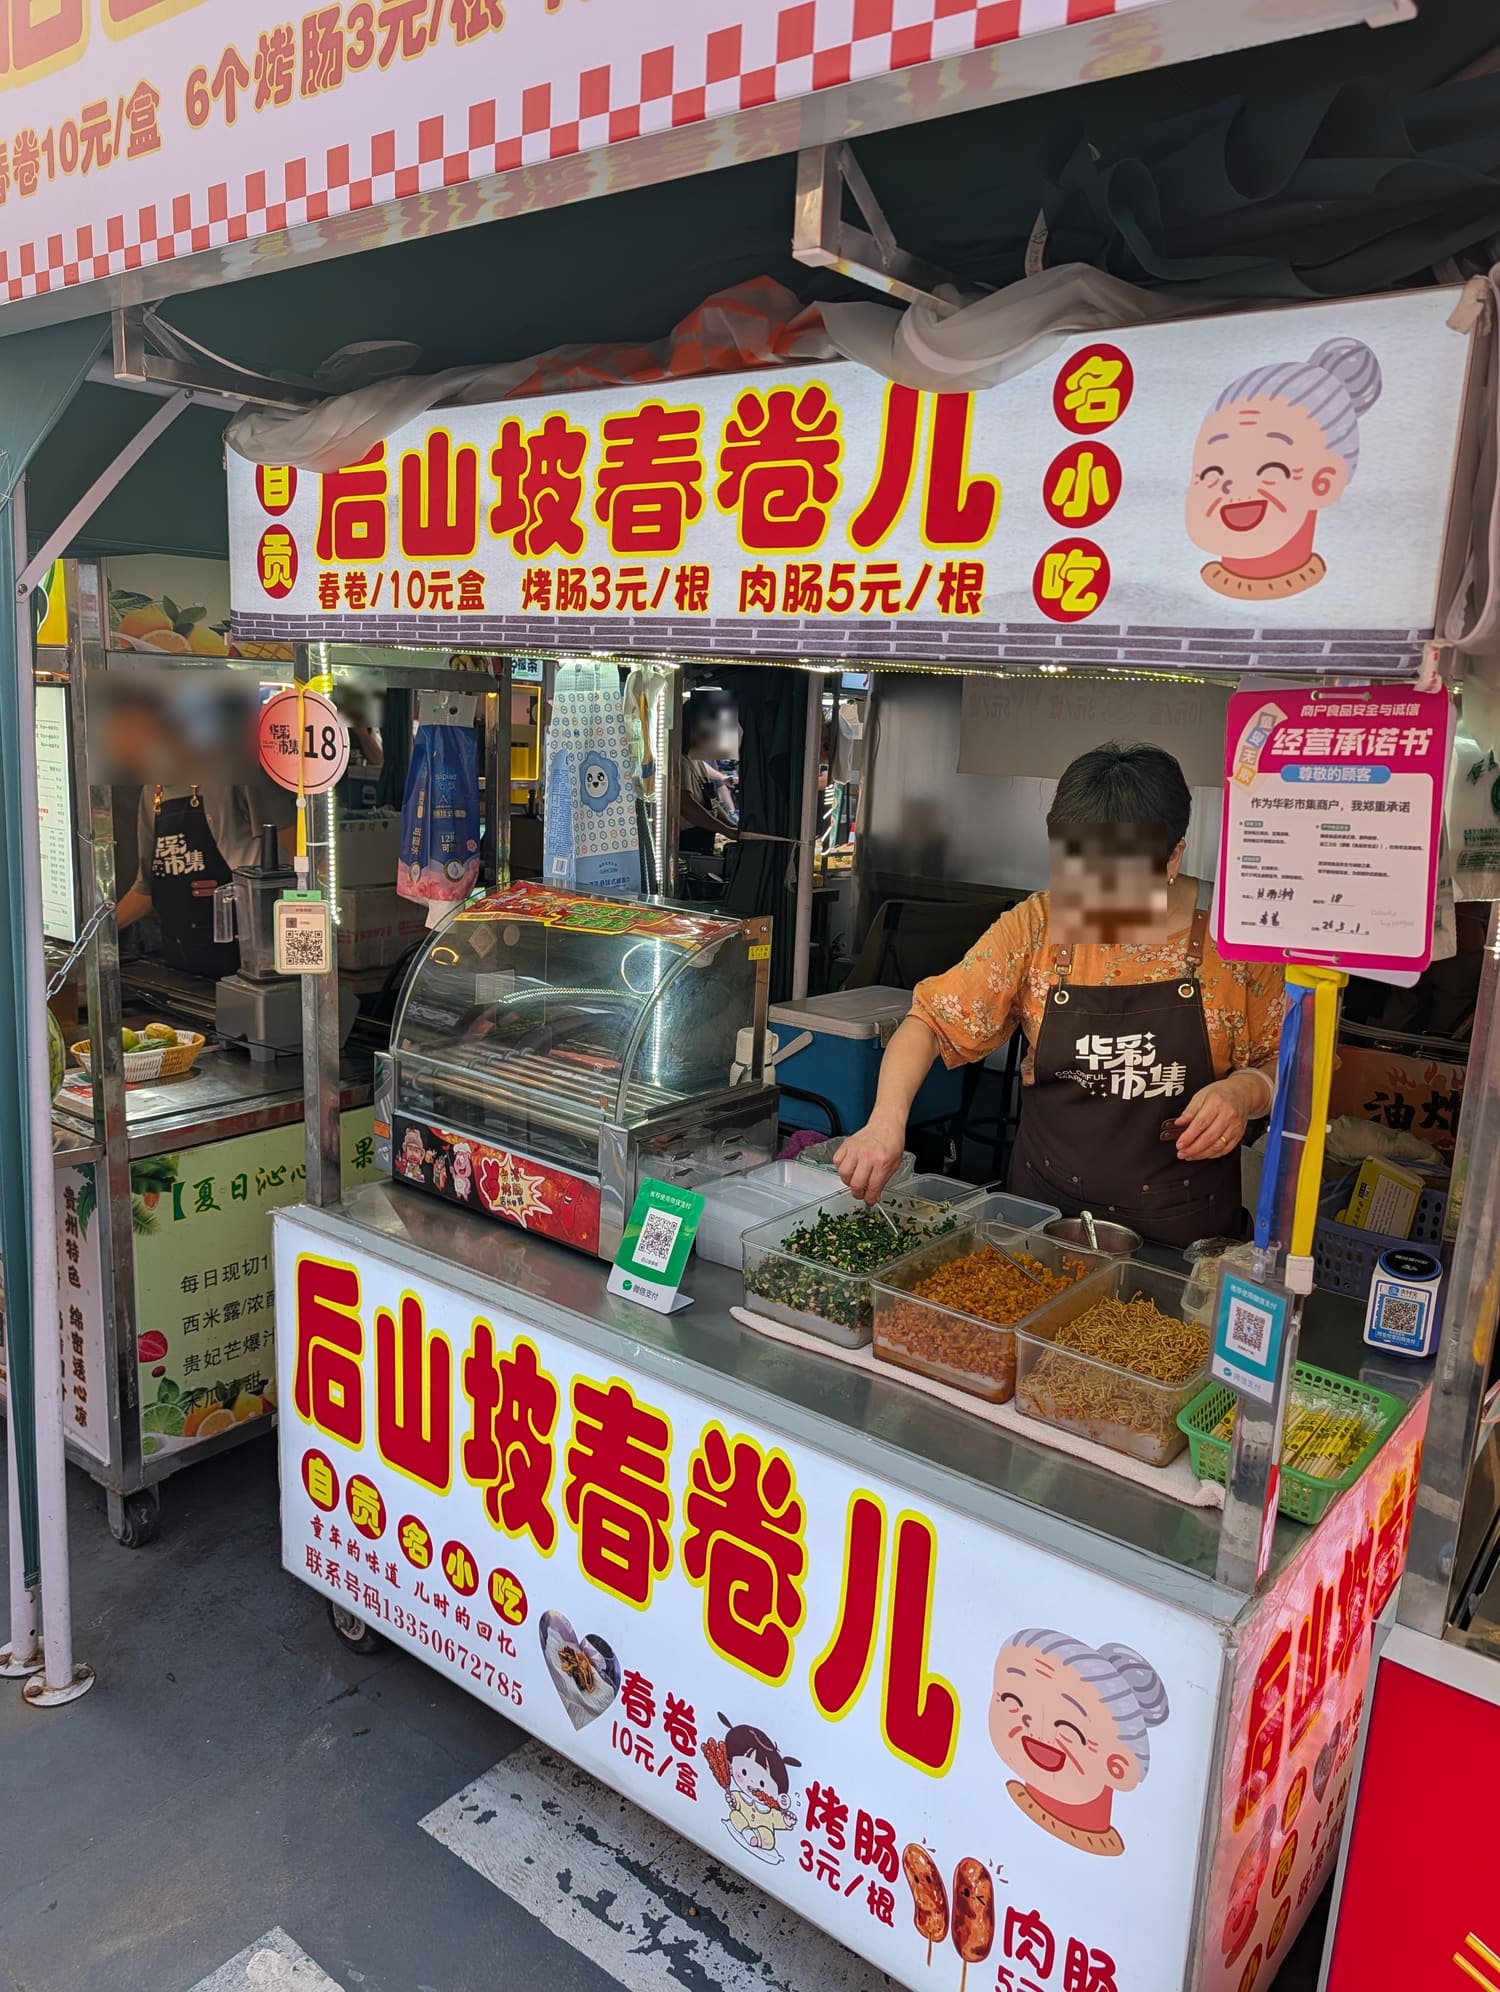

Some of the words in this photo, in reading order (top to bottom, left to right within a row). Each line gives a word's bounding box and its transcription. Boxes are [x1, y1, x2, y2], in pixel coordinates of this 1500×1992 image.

[313, 378, 1000, 565] 后山坡春卷儿
[1038, 353, 1126, 614] 名小吃
[259, 464, 295, 591] 自贡
[317, 568, 487, 611] 春卷/10元盒
[520, 564, 711, 613] 烤肠3元/根
[738, 560, 985, 616] 肉肠5元/根
[303, 725, 337, 761] 18
[1270, 726, 1434, 758] 经营承诺书
[1300, 703, 1421, 719] 商户食品安全与诚信
[1298, 765, 1372, 783] 尊敬的顾客
[1075, 1031, 1157, 1071] 华彩
[1110, 1061, 1188, 1100] 市集
[351, 1136, 374, 1169] 果
[63, 1185, 81, 1289] 贵州特色
[180, 1254, 268, 1294] 每日现切1
[632, 1284, 659, 1302] 微信支付
[292, 1250, 962, 1779] 后山坡春卷儿
[310, 1514, 401, 1590] 童年的味道
[413, 1578, 518, 1659] 儿时的回忆
[620, 1668, 699, 1759] 春卷
[610, 1719, 699, 1803] 10元/盒
[803, 1779, 901, 1883] 烤肠
[798, 1839, 896, 1928] 3元/根
[1002, 1905, 1119, 1992] 肉肠
